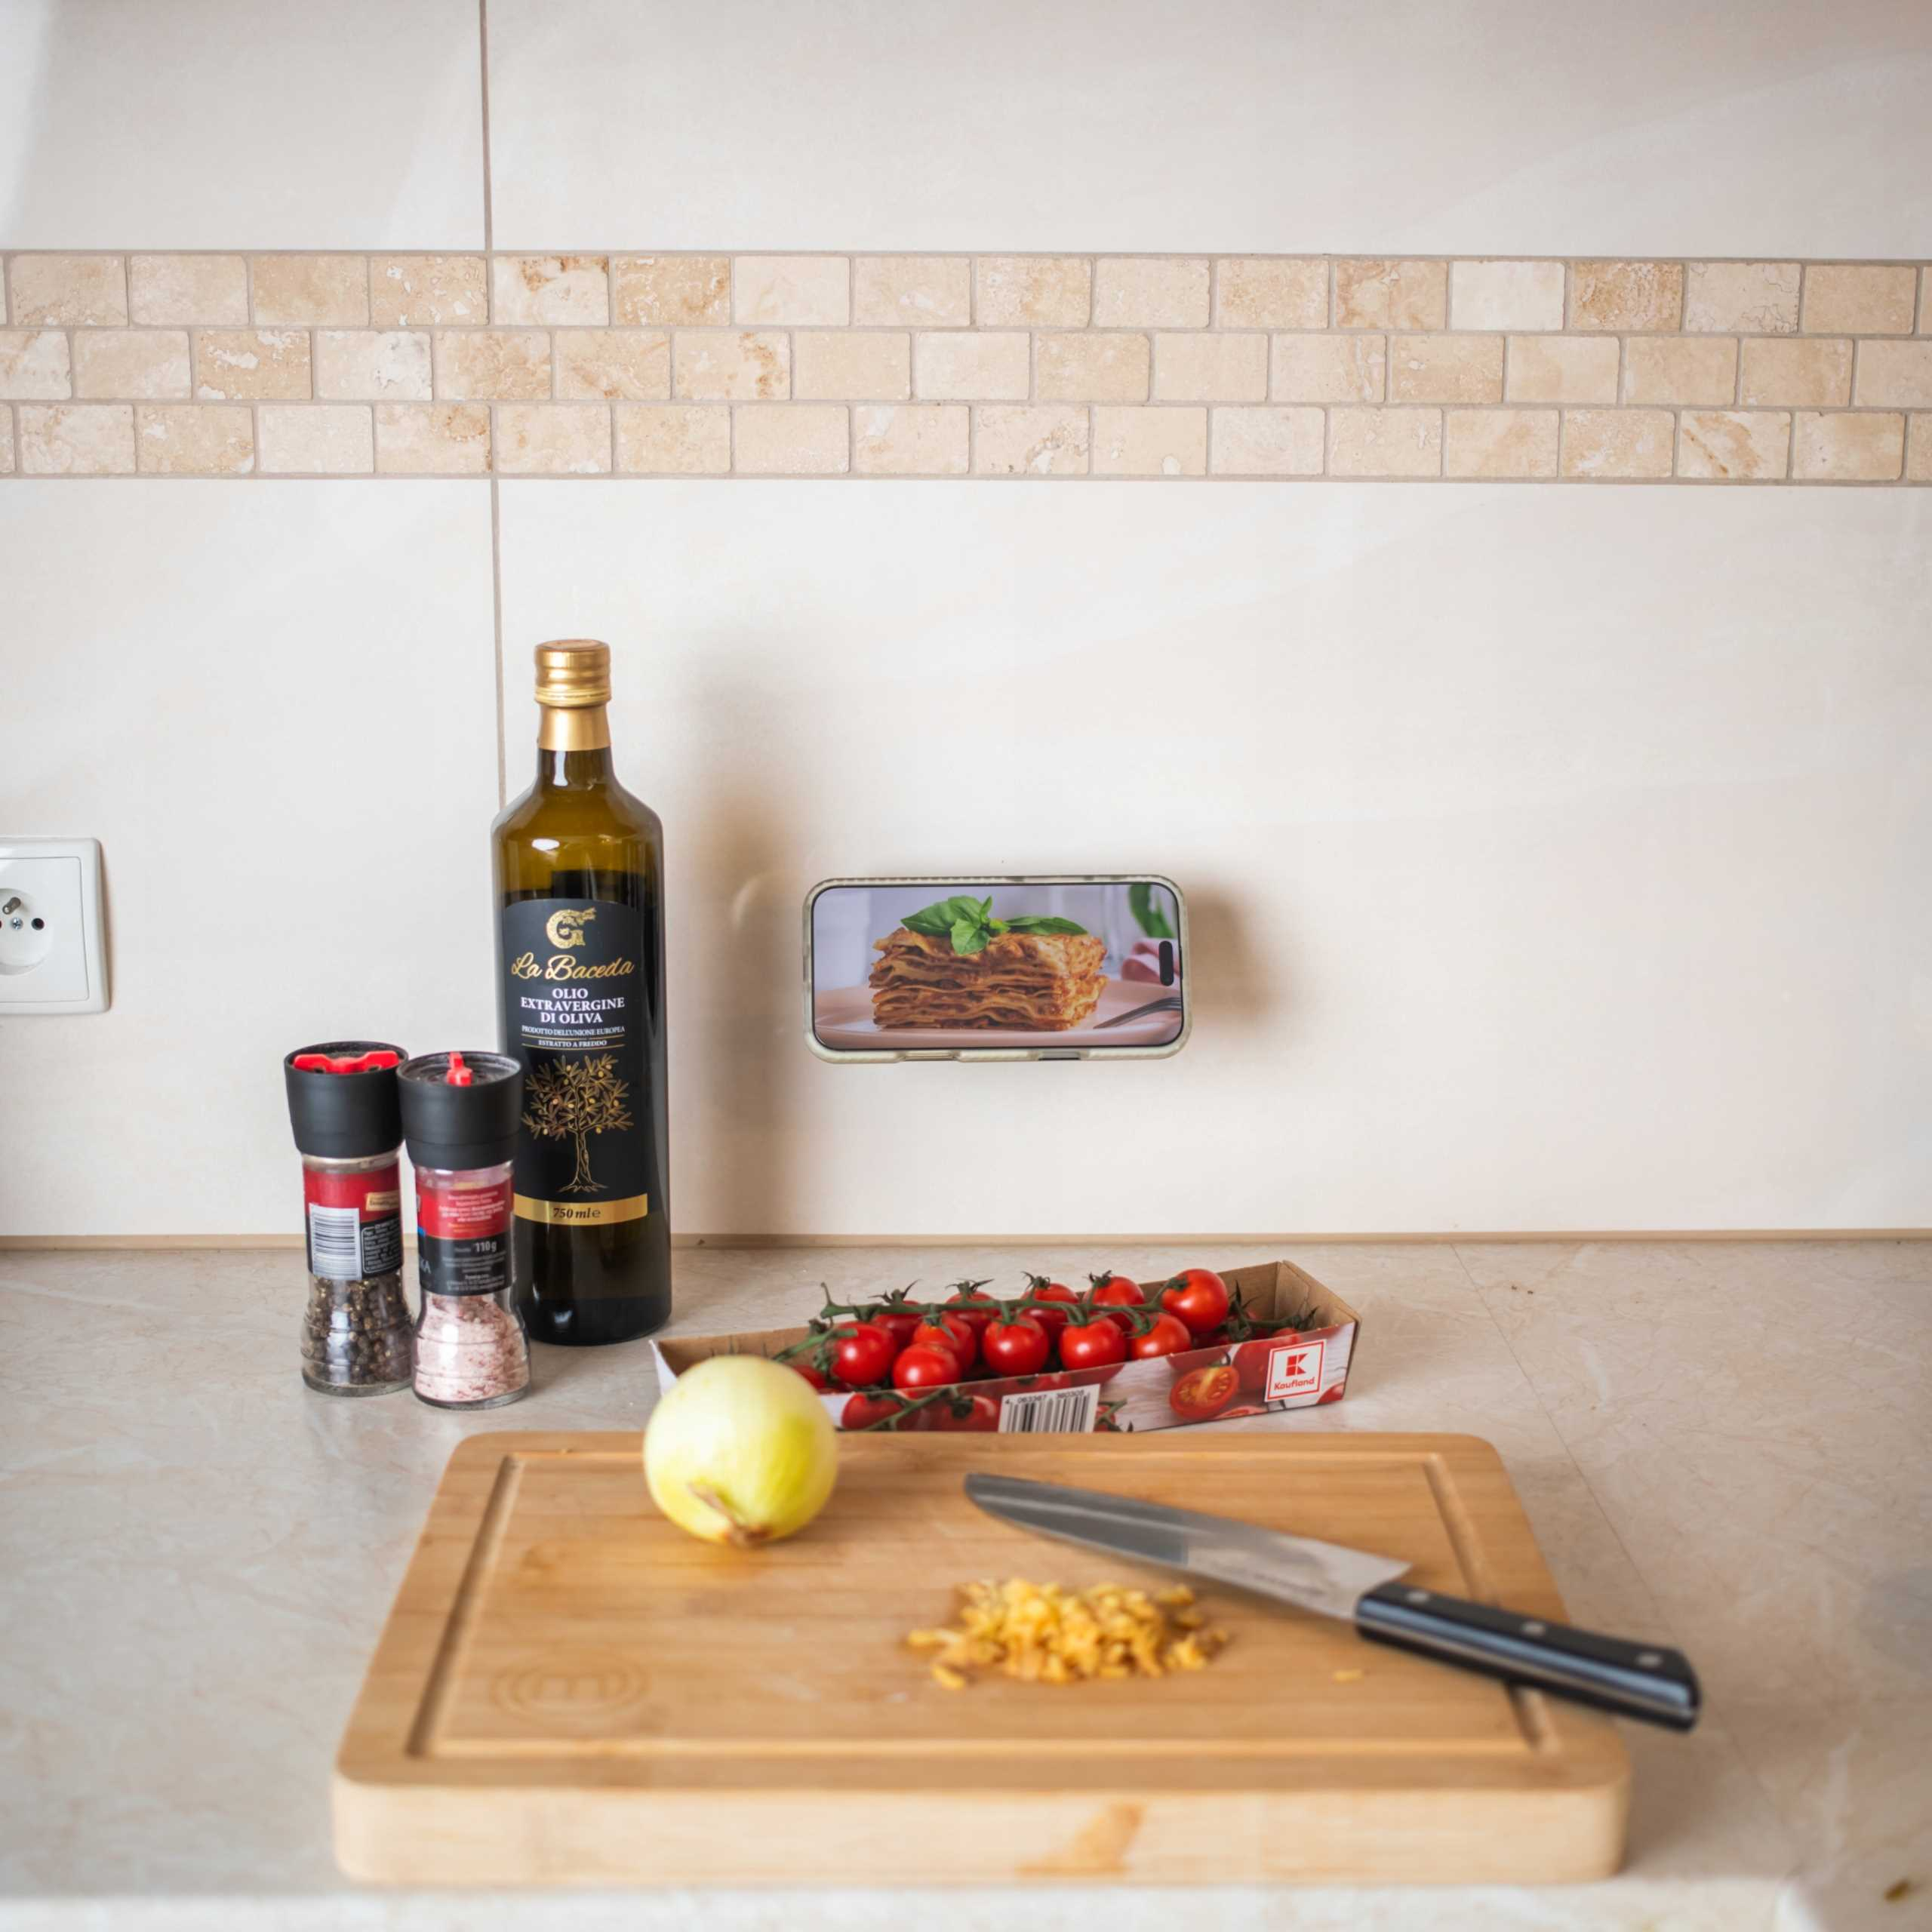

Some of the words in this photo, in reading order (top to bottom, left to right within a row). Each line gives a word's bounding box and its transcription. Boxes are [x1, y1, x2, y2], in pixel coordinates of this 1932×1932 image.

[511, 952, 543, 979] La
[544, 955, 635, 980] Baceda
[552, 988, 589, 999] OLIO
[521, 997, 625, 1011] EXTRAVERGINE
[540, 1012, 555, 1023] DI
[558, 1012, 603, 1024] OLIVA
[521, 1025, 552, 1035] PRODOTTO
[554, 1028, 595, 1036] DELL'UNIONE
[597, 1026, 626, 1035] EUROPEA
[553, 1208, 574, 1219] 750
[1274, 1377, 1315, 1390] Kaufland
